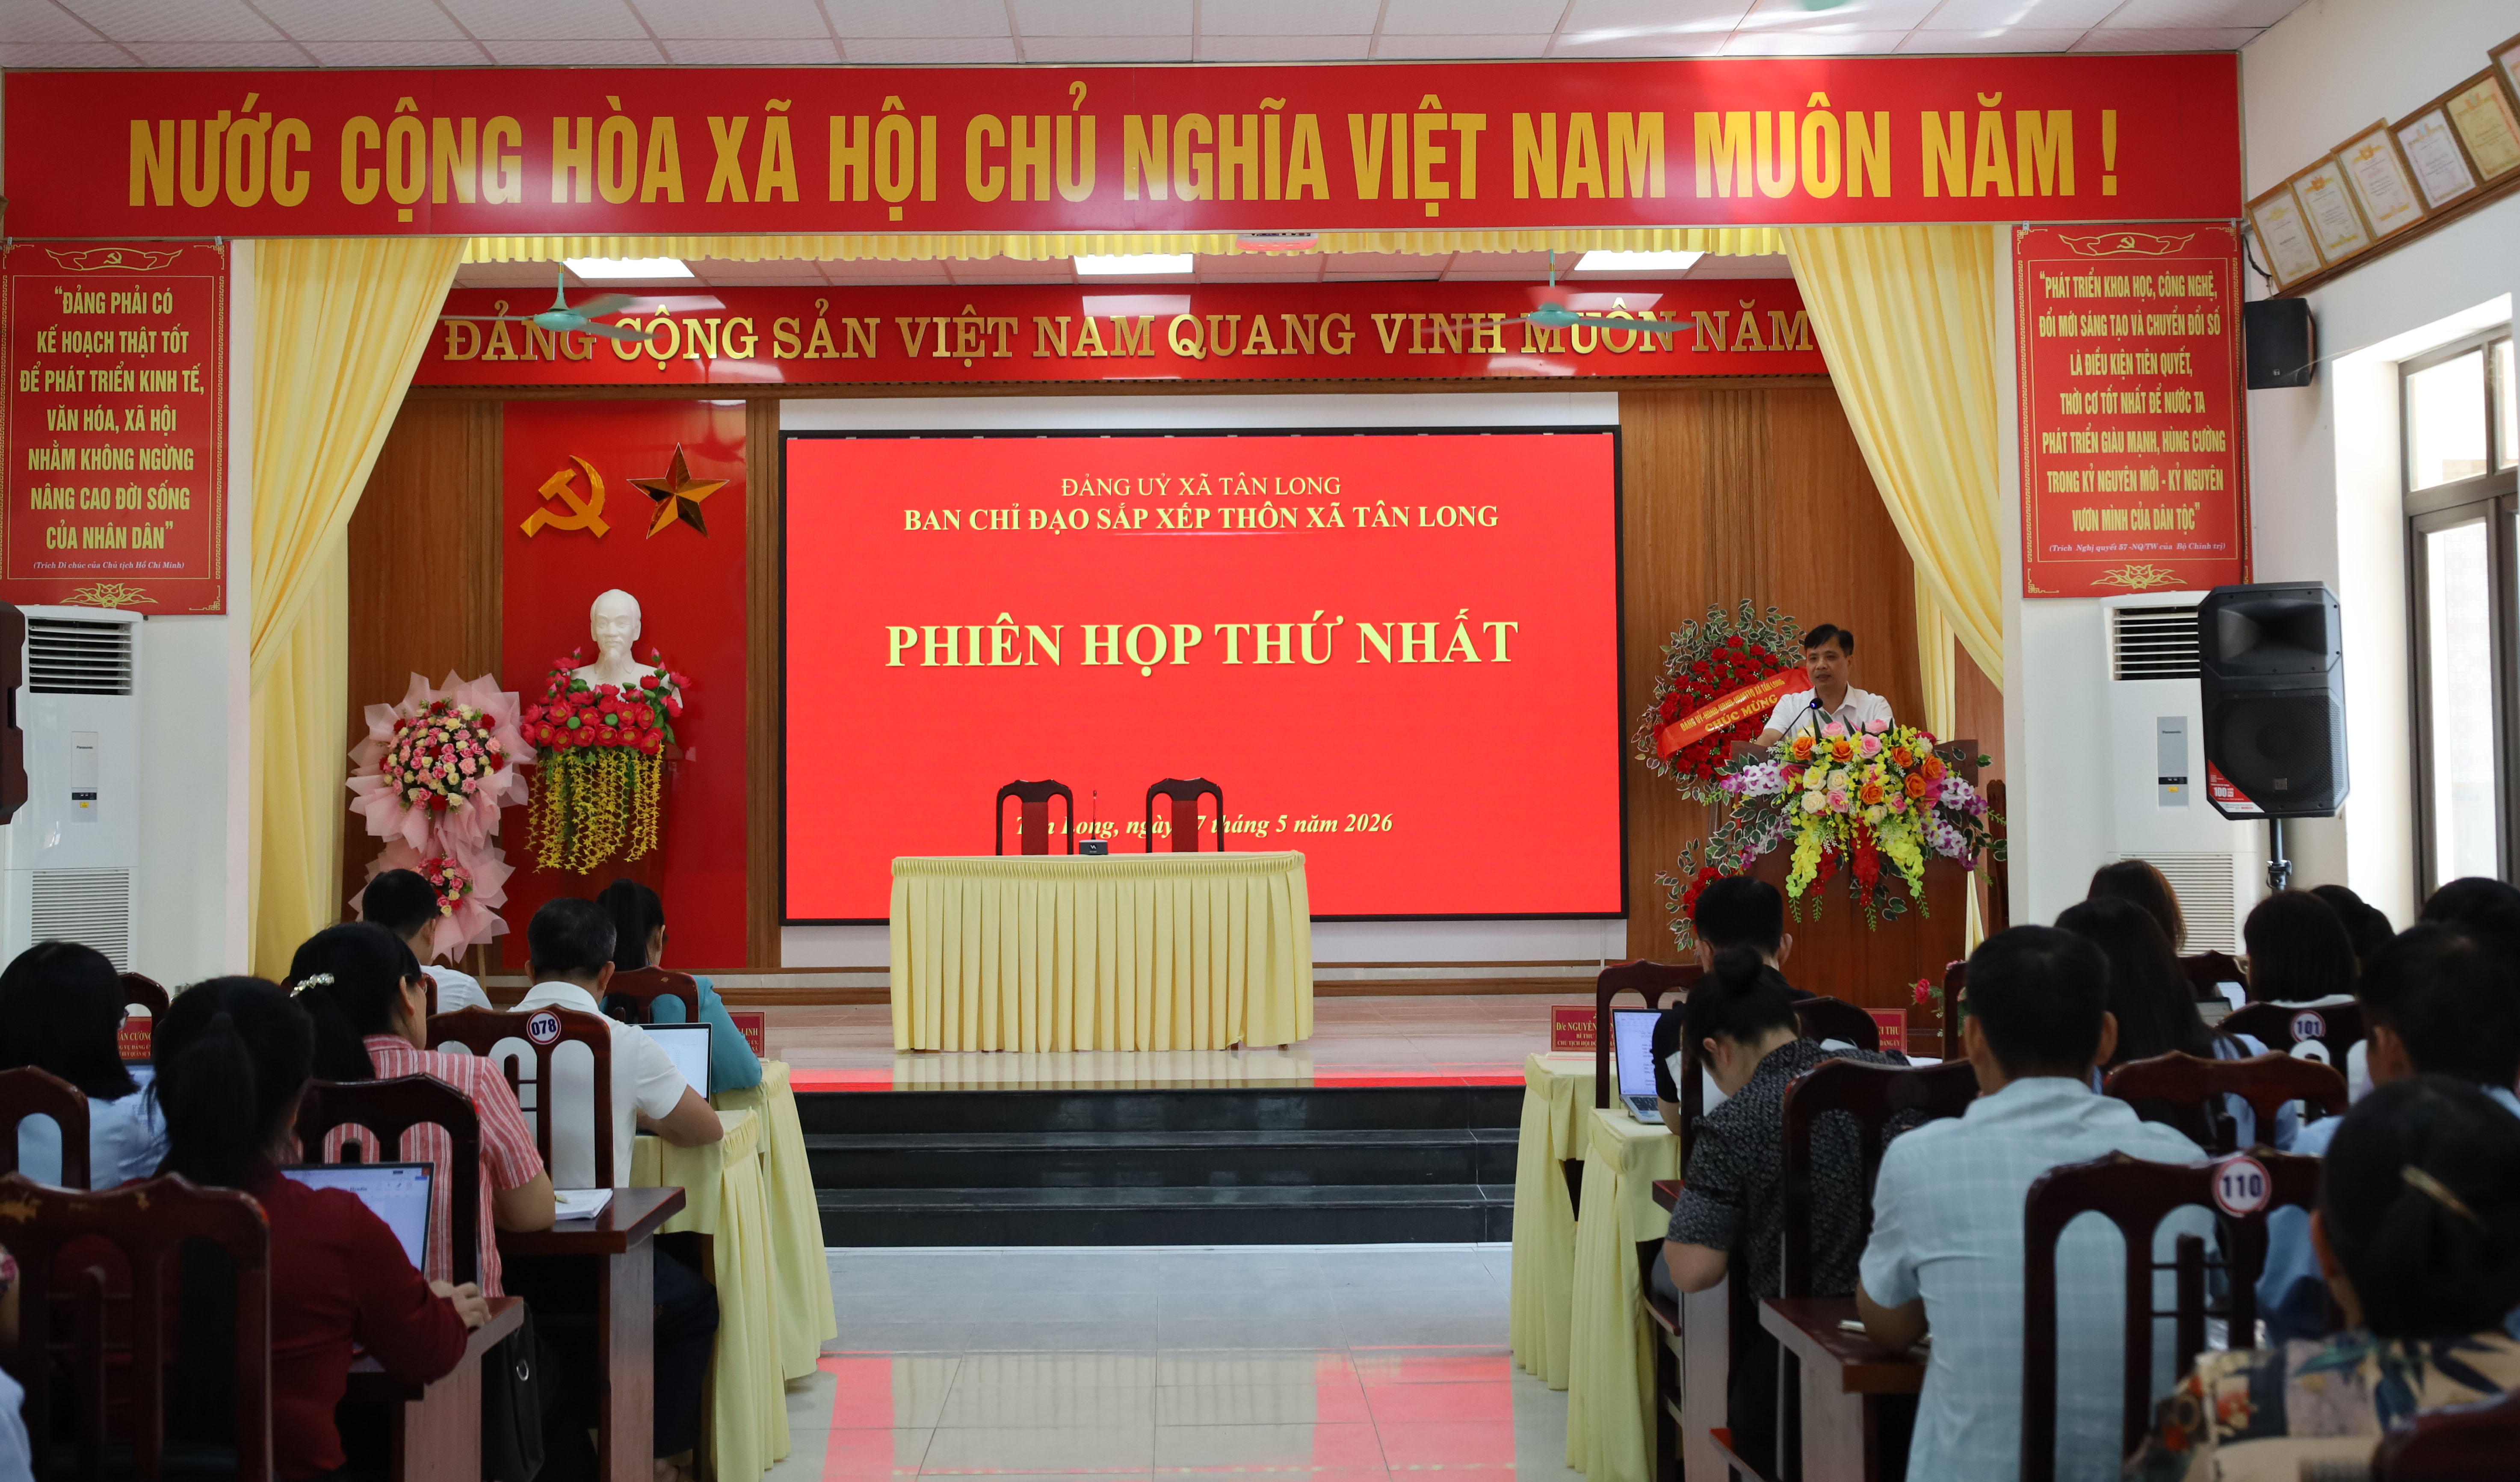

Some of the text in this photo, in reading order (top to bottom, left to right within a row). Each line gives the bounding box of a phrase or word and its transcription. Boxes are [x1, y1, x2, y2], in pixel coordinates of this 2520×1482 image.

[130, 81, 2117, 222] NƯỚC CỘNG HÒA XÃ HỘI CHỦ NGHĨA VIỆT NAM MUÔN NĂM !
[111, 285, 147, 314] PHẢI
[152, 288, 172, 314] CÓ
[2073, 267, 2101, 298] TRIỂN
[2104, 276, 2130, 297] KHOA
[2133, 276, 2156, 302] HỌC,
[2159, 271, 2185, 297] CÔNG
[2188, 271, 2217, 301] NGHỆ,
[444, 297, 1813, 370] ĐẢNG CỘNG SẢN VIỆT NAM QUANG VINH MUÔN NĂM
[2039, 305, 2220, 341] ĐỔI MỚI SÁNG TẠO VÀ CHUYỂN ĐỔI SỐ
[38, 323, 189, 358] KẾ HOẠCH THẬT TỐT
[20, 361, 204, 395] ĐỂ PHÁT TRIỂN KINH TẾ,
[2070, 346, 2192, 380] LÀ ĐIỀU KIỆN TIÊN QUYẾT,
[2060, 383, 2205, 415] THỜI CƠ TỐT NHẤT ĐỂ NƯỚC TA
[47, 405, 176, 436] VĂN HÓA, XÃ HỘI
[29, 440, 193, 470] NHẰM KHÔNG NGỪNG
[2042, 422, 2225, 457] PHÁT TRIỂN GIÀU MẠNH, HÙNG CƯỜNG
[1062, 472, 1340, 496] ĐẢNG UỶ XÃ TÂN LONG
[2047, 471, 2079, 493] TRONG
[2082, 463, 2094, 492] KỶ
[2097, 465, 2137, 492] NGUYÊN
[2139, 465, 2159, 491] MỚI
[2168, 462, 2181, 491] KỶ
[2184, 465, 2223, 491] NGUYÊN
[31, 480, 190, 510] NÂNG CAO ĐỜI SỐNG
[904, 501, 1499, 535] BAN CHỈ ĐẠO SẮP XẾP THÔN XÃ TÂN LONG
[2072, 507, 2099, 532] VƯƠN
[2101, 504, 2128, 531] MÌNH
[2130, 501, 2151, 531] CỦA
[2153, 504, 2174, 530] DÂN
[47, 519, 77, 549] CỦA
[83, 522, 127, 548] NHÂN
[119, 561, 134, 570] tịch
[135, 560, 147, 569] Hồ
[885, 609, 1518, 676] PHIÊN HỌP THỨ NHẤT
[1705, 694, 1778, 732] CHÚC MỪNG
[2214, 787, 2227, 797] 100
[1211, 814, 1270, 838] tháng
[1276, 815, 1289, 832] 5
[1294, 814, 1338, 833] năm
[1344, 813, 1393, 832] 2026
[531, 1019, 556, 1035] 078
[2297, 1021, 2320, 1034] 101
[2224, 1174, 2261, 1197] 110
